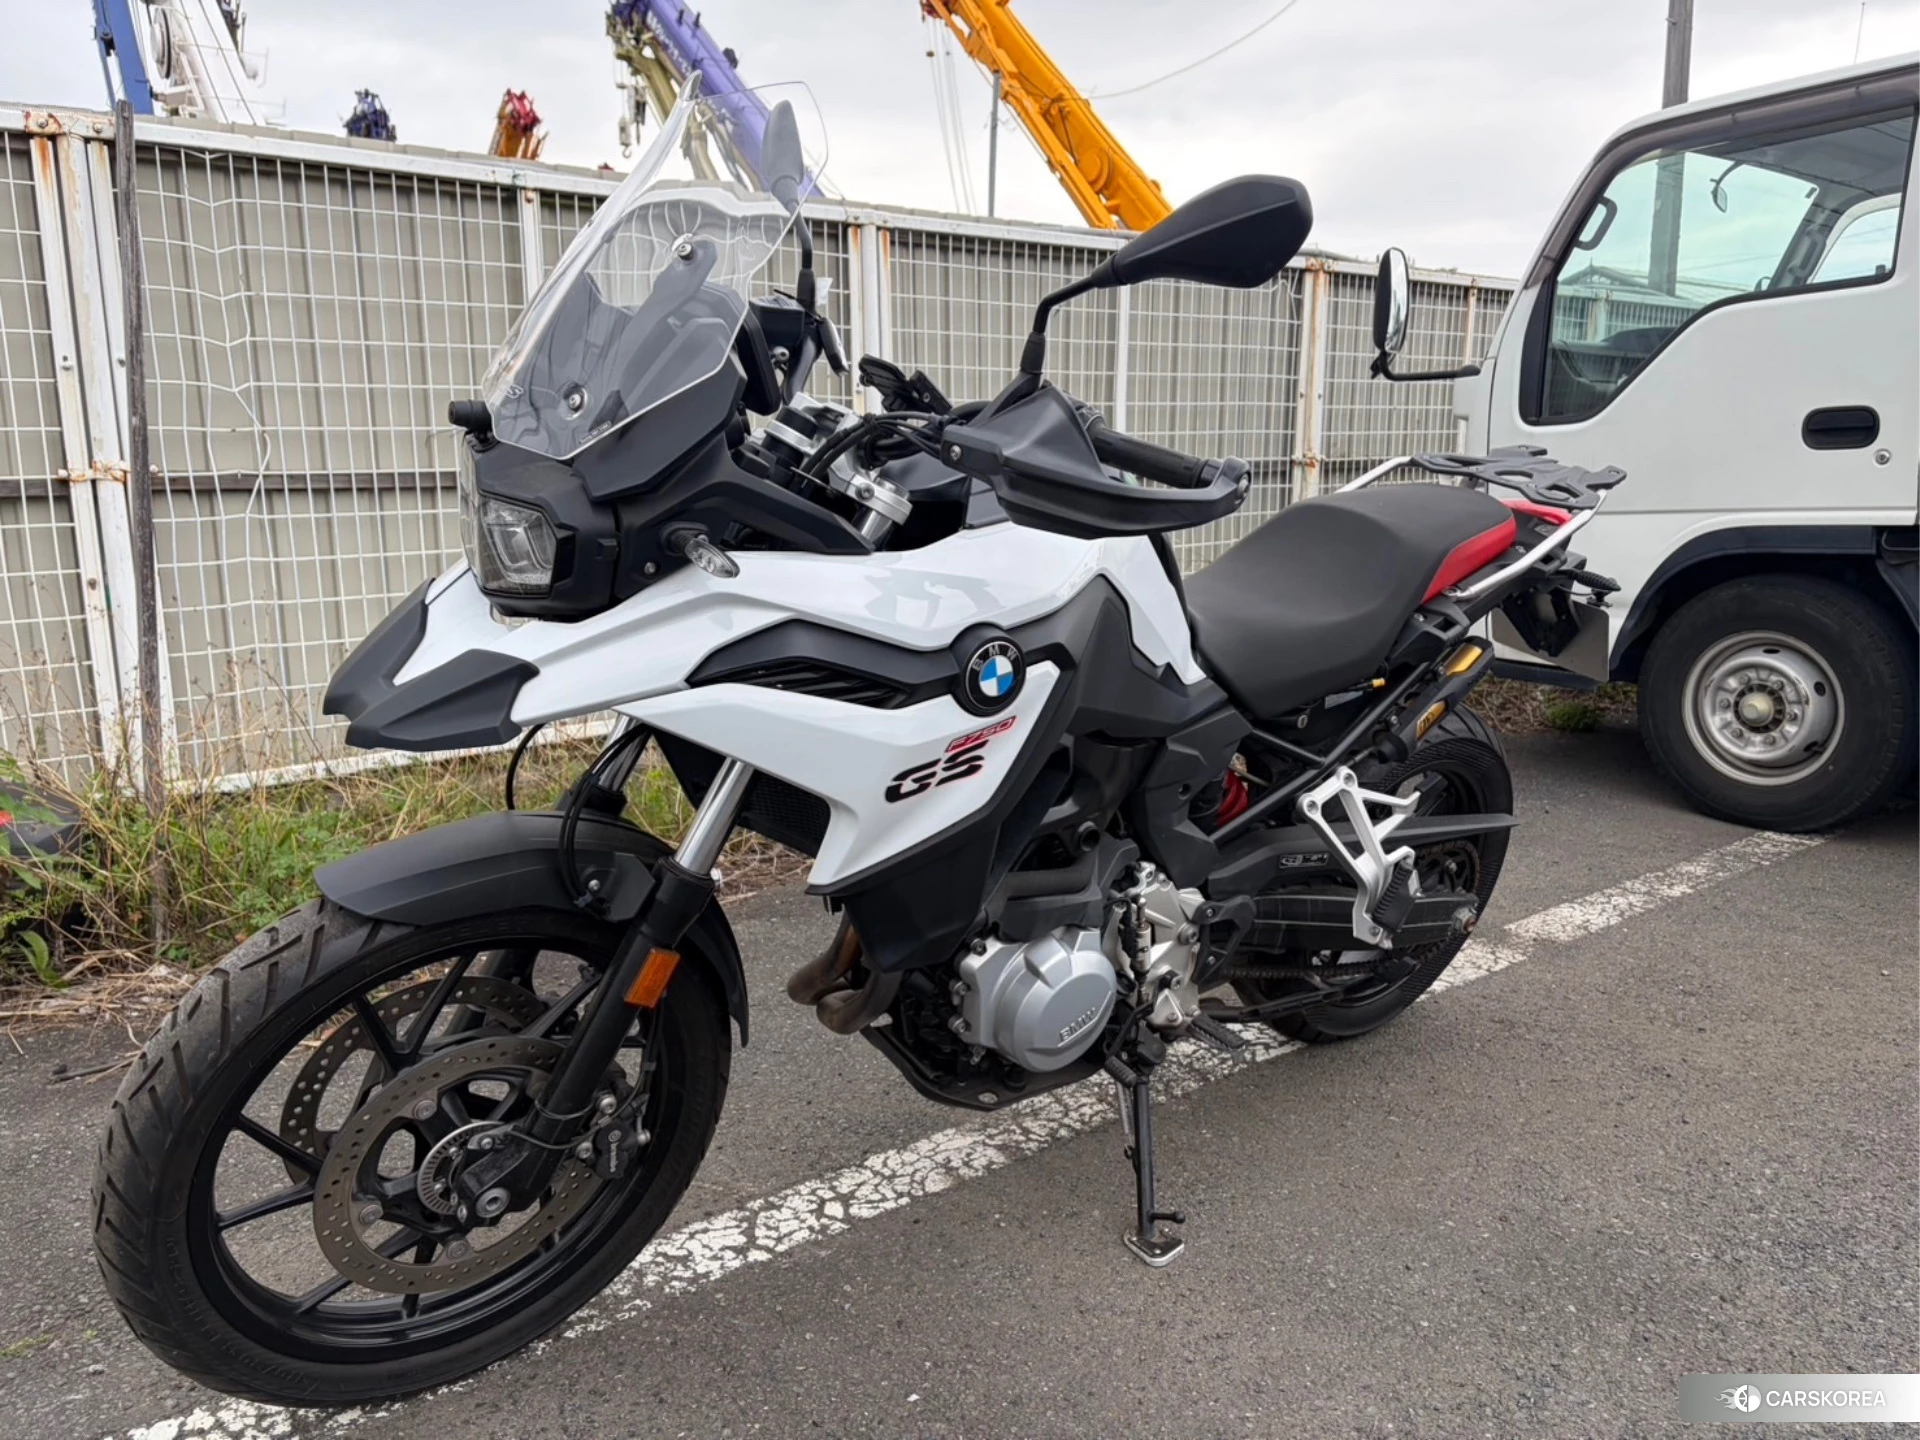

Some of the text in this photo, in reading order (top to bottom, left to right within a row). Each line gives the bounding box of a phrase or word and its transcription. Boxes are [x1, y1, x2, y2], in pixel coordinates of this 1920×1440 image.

[971, 644, 1018, 671] BMW
[885, 739, 989, 803] GS
[1059, 1006, 1097, 1042] BMW
